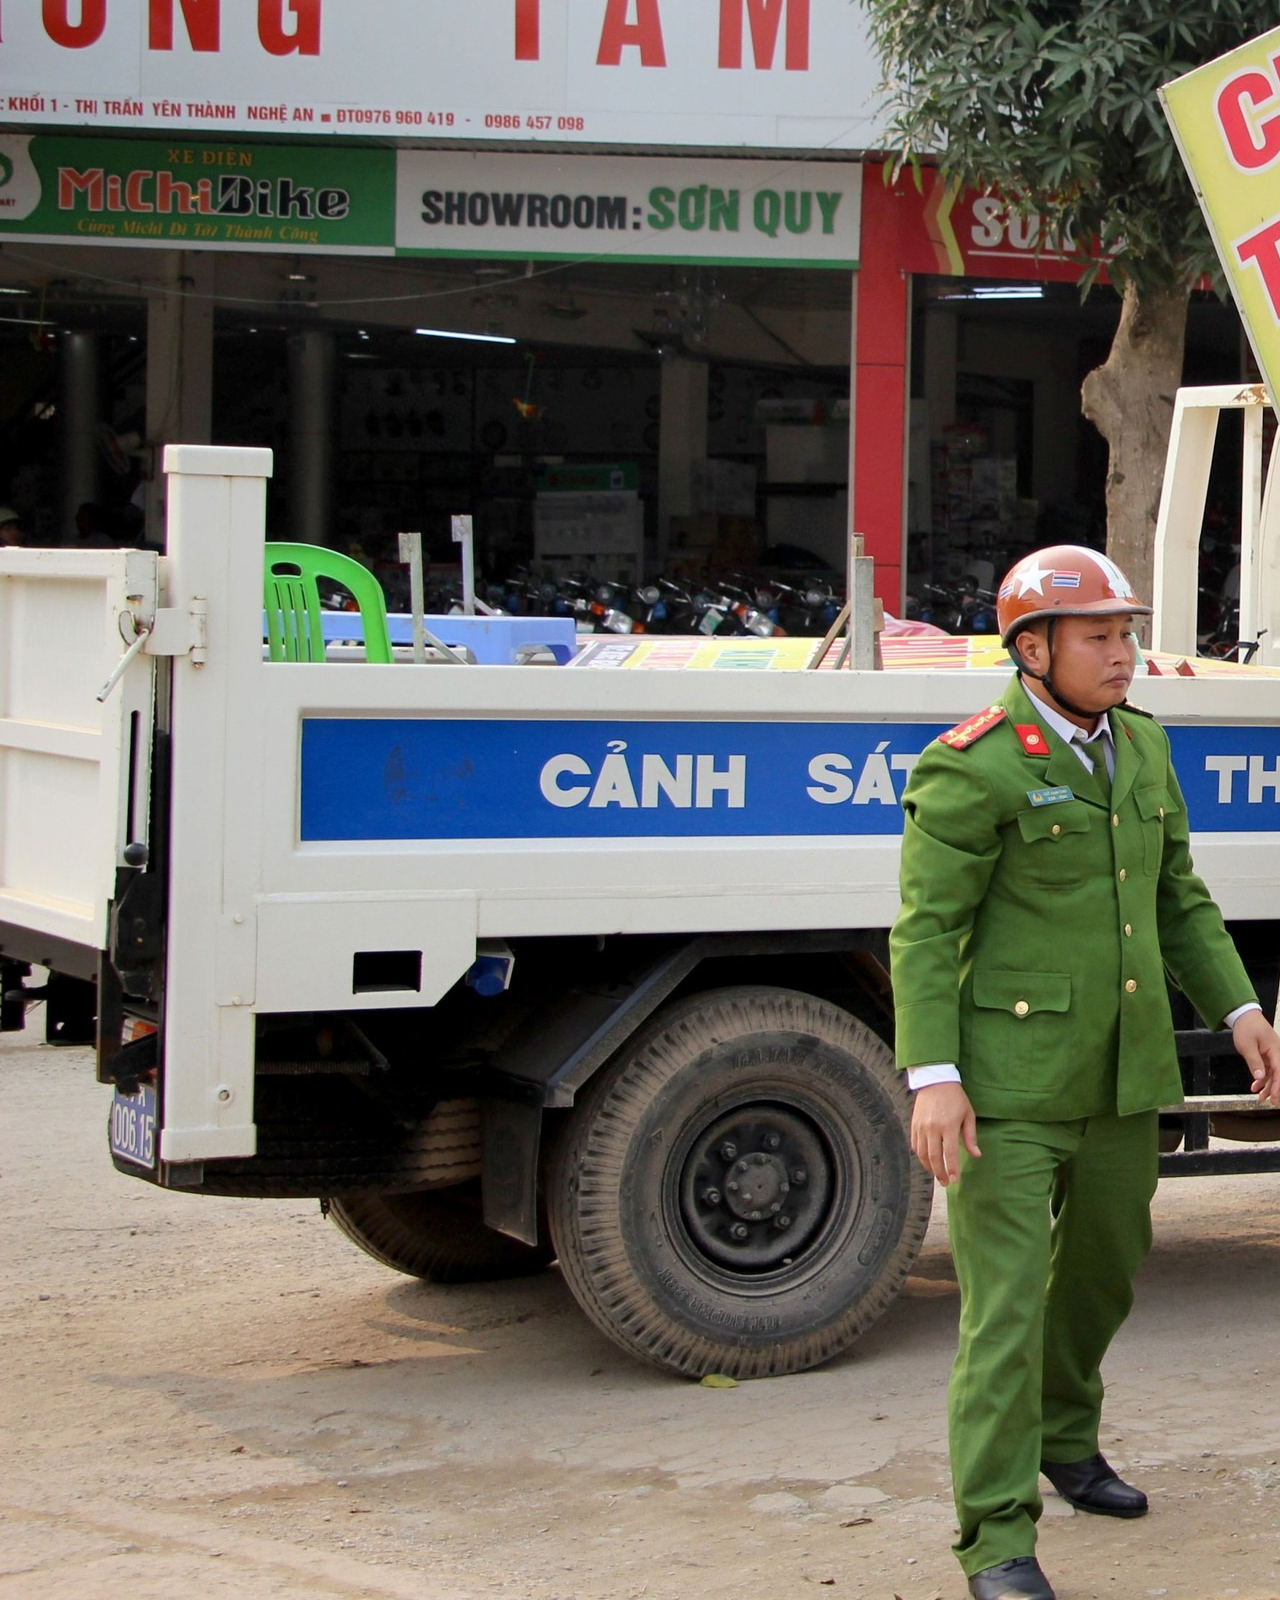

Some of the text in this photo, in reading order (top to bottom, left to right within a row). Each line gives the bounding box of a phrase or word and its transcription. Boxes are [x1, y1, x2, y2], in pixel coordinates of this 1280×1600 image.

[9, 92, 45, 112] KHỐI
[51, 99, 58, 113] 1
[75, 100, 97, 119] THỊ
[104, 97, 143, 117] TRẤN
[152, 99, 181, 118] YÊN
[186, 99, 236, 119] THÀNH
[247, 103, 287, 124] NGHỆ
[293, 109, 313, 123] AN
[396, 111, 423, 126] 960
[427, 112, 454, 127] 419
[485, 115, 520, 130] 0986
[526, 116, 552, 131] 457
[557, 116, 585, 132] 098
[167, 149, 253, 168] XE ĐIỆN
[647, 183, 740, 232] SƠN
[752, 190, 844, 239] QUY
[539, 739, 747, 809] CẢNH
[805, 740, 921, 805] SÁT
[114, 1102, 154, 1160] 006.15
